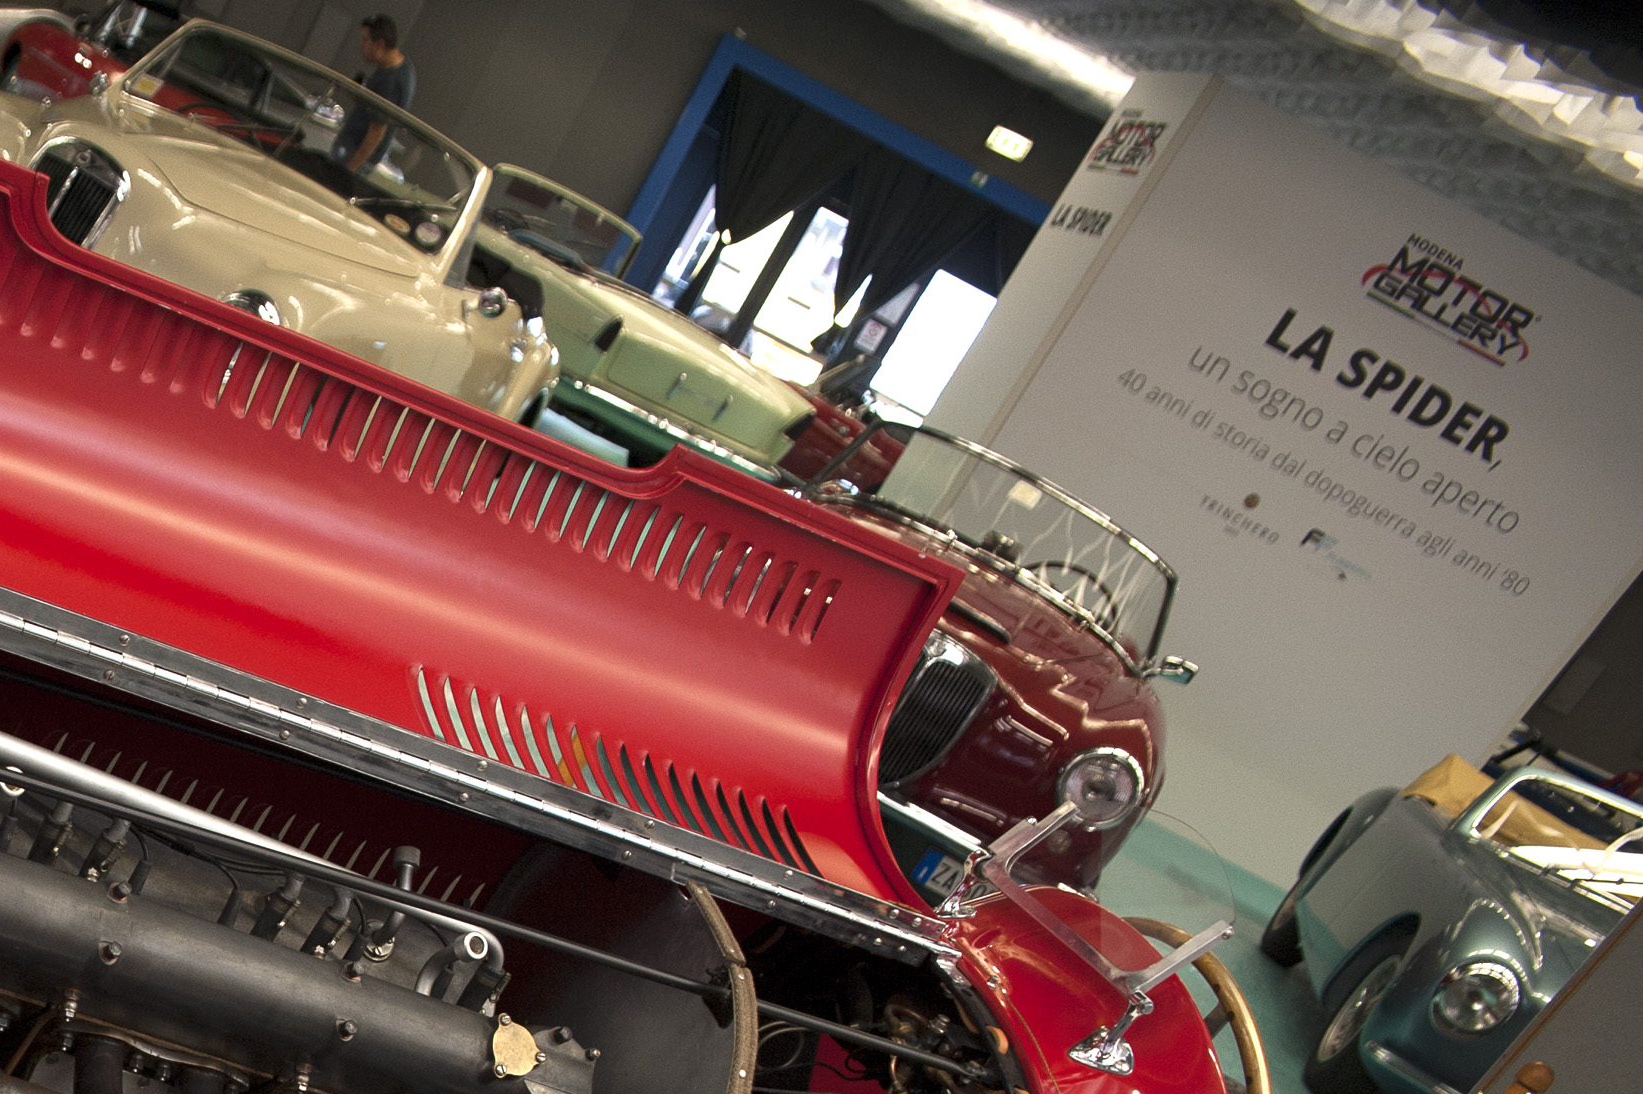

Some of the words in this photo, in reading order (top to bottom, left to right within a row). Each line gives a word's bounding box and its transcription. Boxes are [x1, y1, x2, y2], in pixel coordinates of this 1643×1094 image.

[1373, 271, 1523, 357] GALLERY
[1387, 244, 1535, 339] MOTOR
[1407, 232, 1465, 271] MODENA
[1188, 345, 1231, 383] un
[1231, 369, 1324, 431] sogno
[1325, 420, 1349, 444] a
[1352, 433, 1420, 482] cielo
[1420, 470, 1520, 534] aperto
[1265, 306, 1335, 373] LA
[1335, 347, 1510, 473] SPIDER,
[1117, 368, 1148, 396] 40
[1144, 386, 1195, 419] anni
[1191, 408, 1217, 431] di
[1214, 421, 1271, 461] storia
[1270, 450, 1307, 480] dal
[1304, 468, 1417, 539] dopoguerra
[1416, 530, 1456, 558] agli
[1452, 548, 1501, 583] anni
